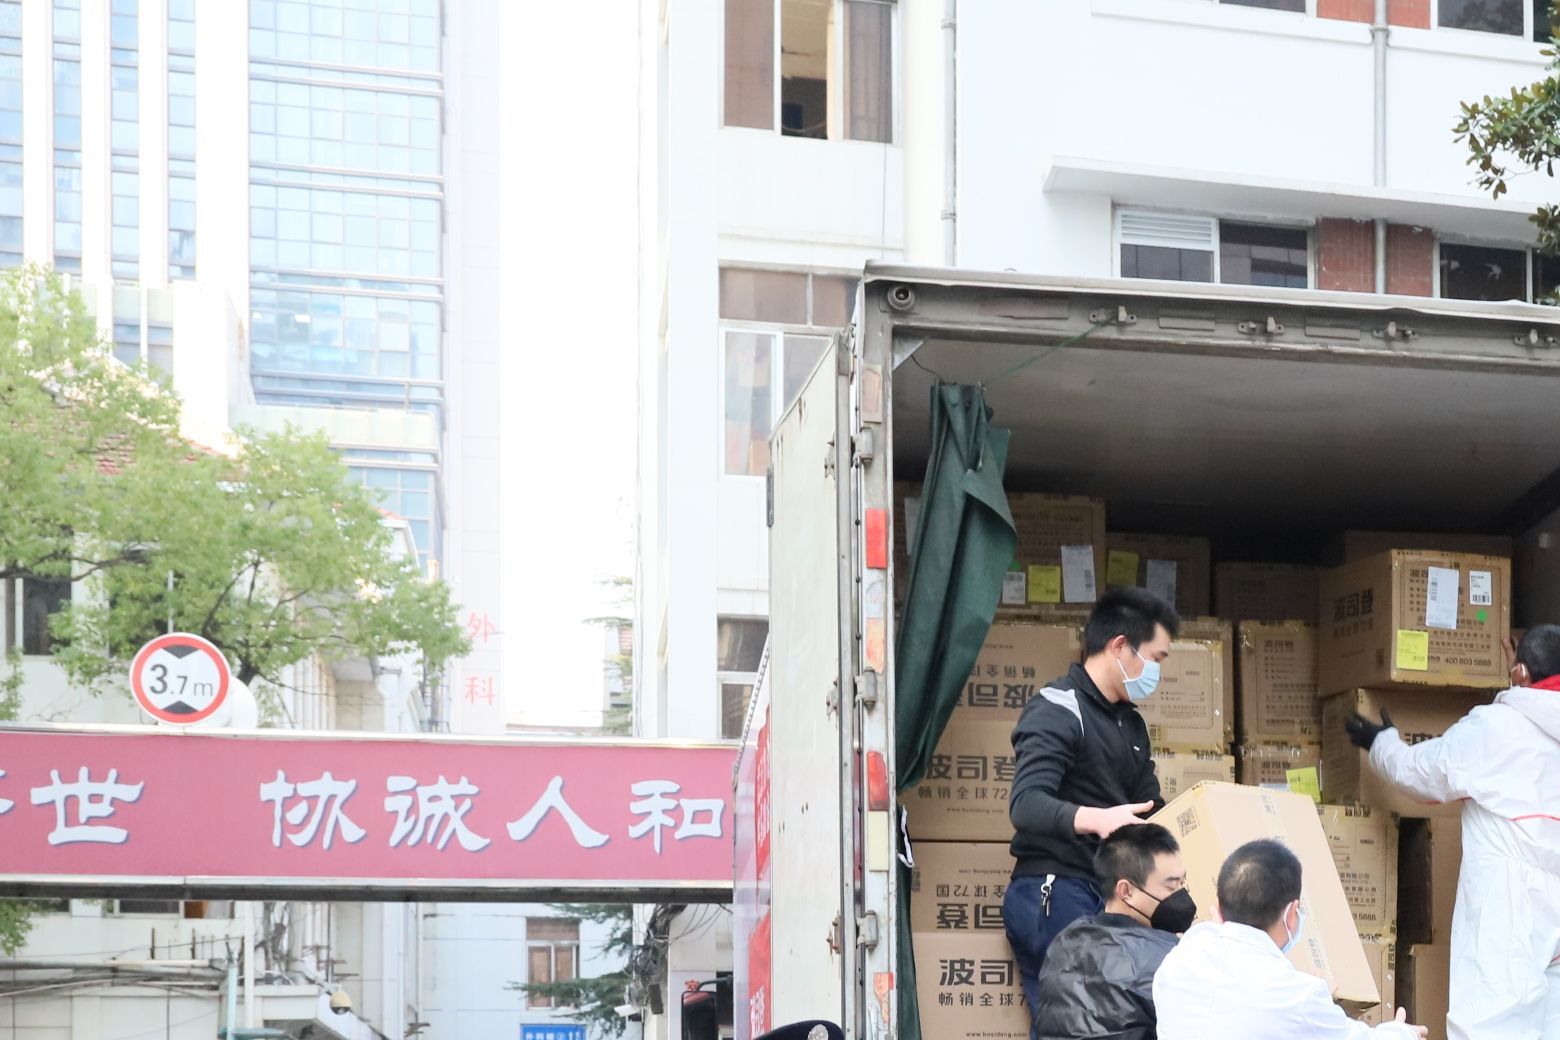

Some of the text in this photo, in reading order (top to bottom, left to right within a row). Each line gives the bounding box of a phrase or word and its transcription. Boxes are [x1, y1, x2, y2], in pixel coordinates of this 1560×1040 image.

[960, 683, 1035, 709] 波司
[0, 767, 144, 847] 世
[259, 769, 726, 856] 协诚人和
[939, 959, 1023, 986] 波司
